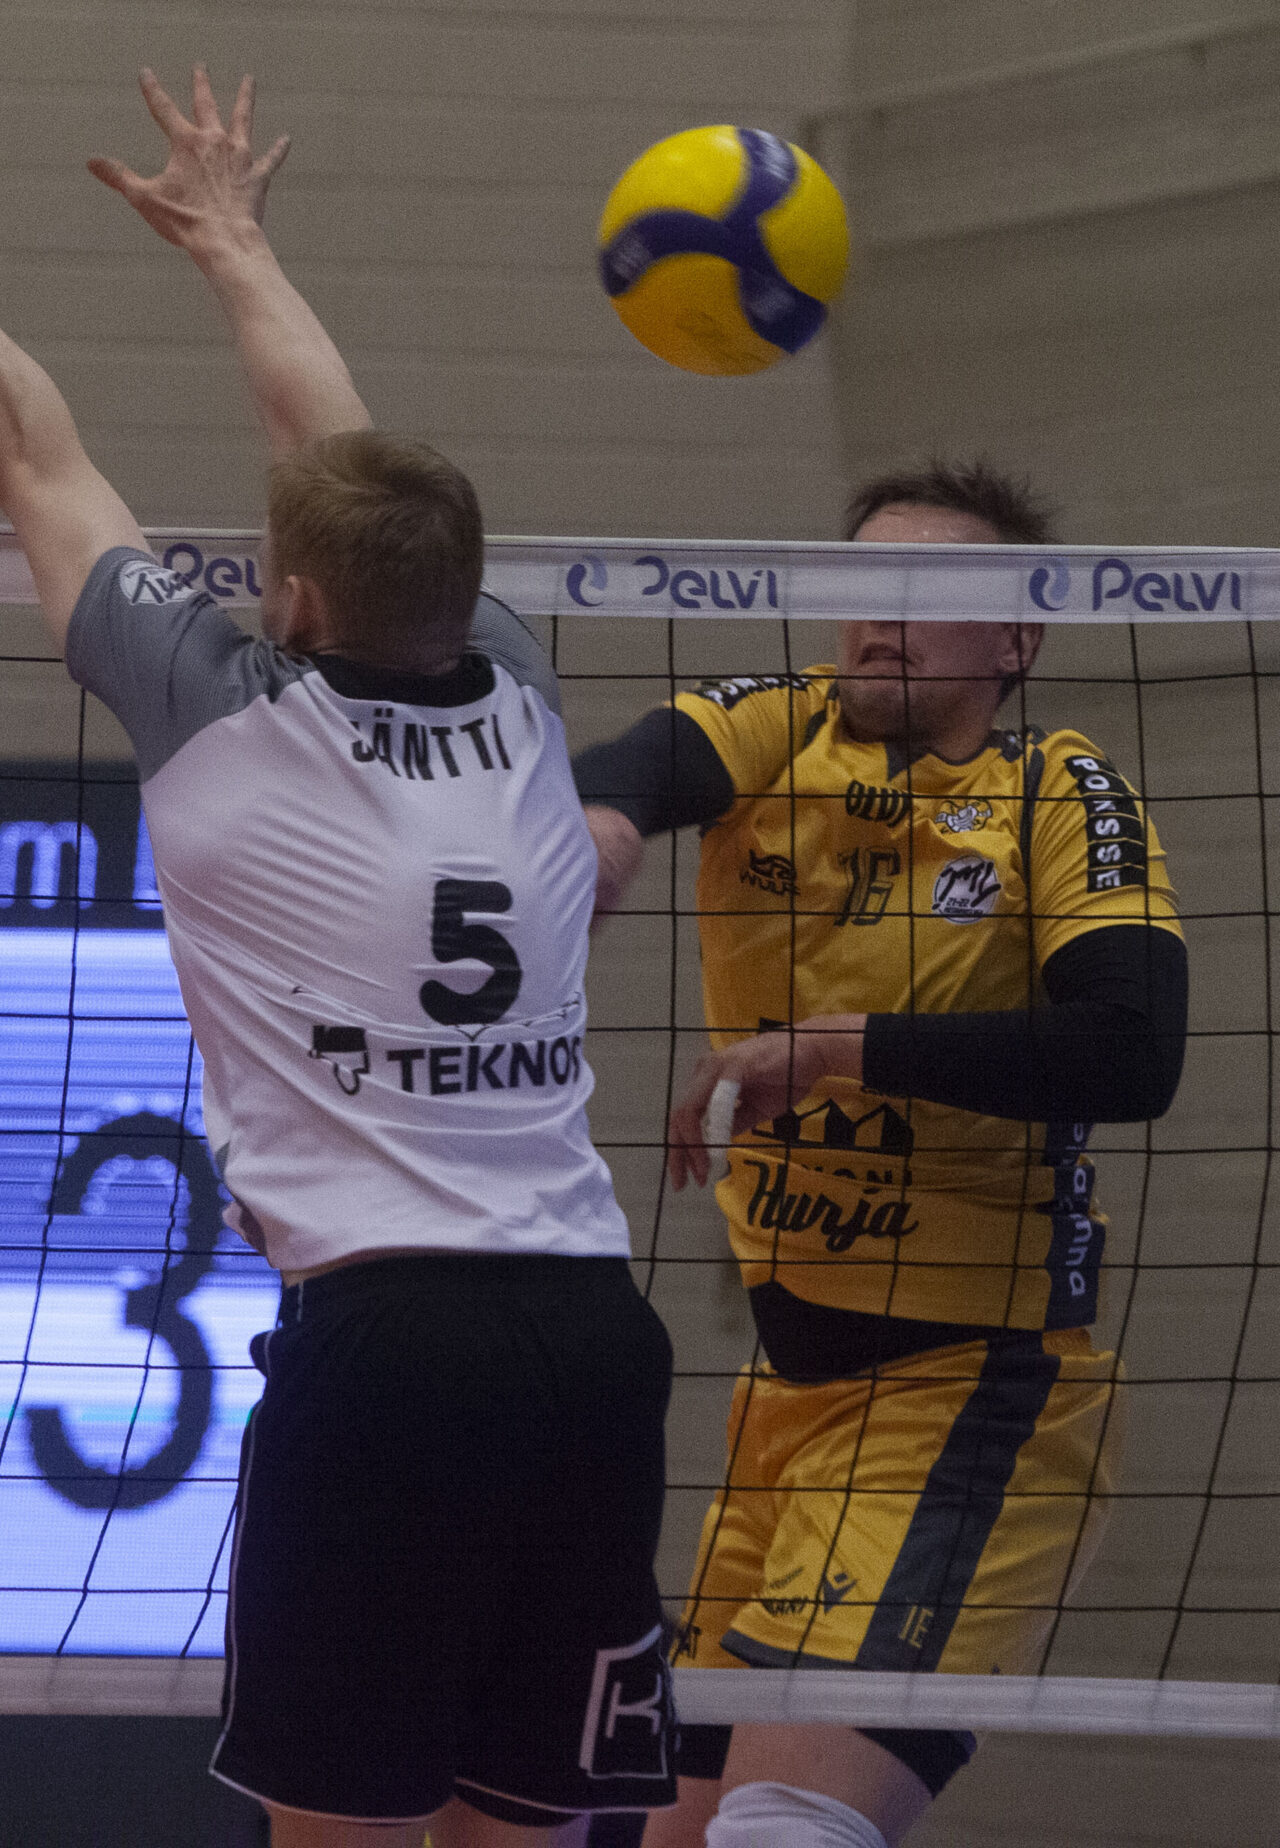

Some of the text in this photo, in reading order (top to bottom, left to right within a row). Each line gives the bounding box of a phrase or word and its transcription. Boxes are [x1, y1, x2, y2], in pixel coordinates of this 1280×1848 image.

[351, 707, 514, 781] JÄNTTI
[419, 878, 523, 1026] 5
[386, 1036, 583, 1098] TEKNOS
[743, 1158, 920, 1253] Hurja
